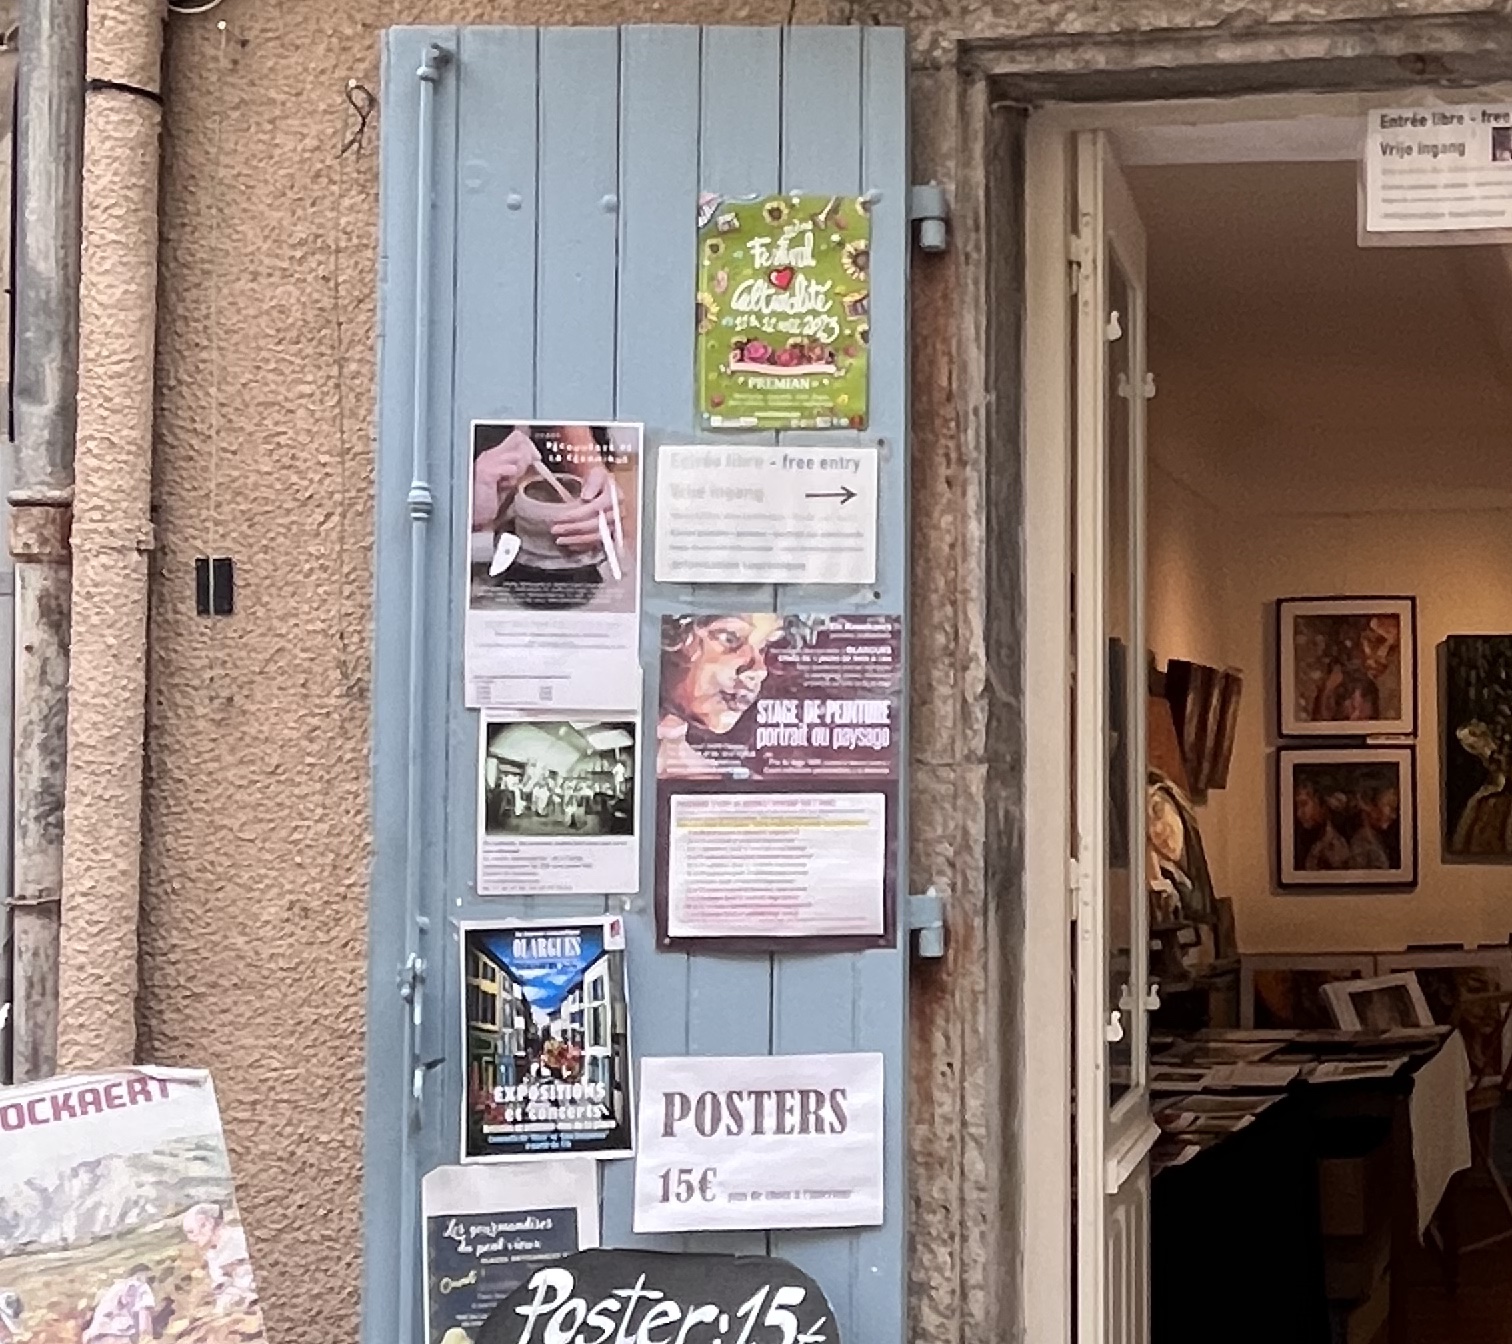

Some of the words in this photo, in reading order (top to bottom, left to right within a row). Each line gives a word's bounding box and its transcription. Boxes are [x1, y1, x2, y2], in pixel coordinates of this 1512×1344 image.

[1380, 113, 1428, 129] Entrée
[1432, 112, 1464, 126] libre
[1481, 110, 1510, 124] free
[1380, 142, 1413, 160] Vrije
[748, 378, 810, 390] PREMIAN
[783, 454, 815, 470] free
[820, 455, 860, 474] entry
[757, 699, 799, 723] STAGE
[804, 699, 822, 723] DE
[825, 699, 892, 723] PEINTURE
[757, 723, 808, 750] portrait
[811, 727, 830, 747] ou
[833, 727, 890, 750] paysage
[513, 936, 582, 958] OLARGUES
[494, 1082, 606, 1103] EXPOSITIONS
[660, 1088, 849, 1138] POSTERS
[658, 1167, 717, 1203] 15€
